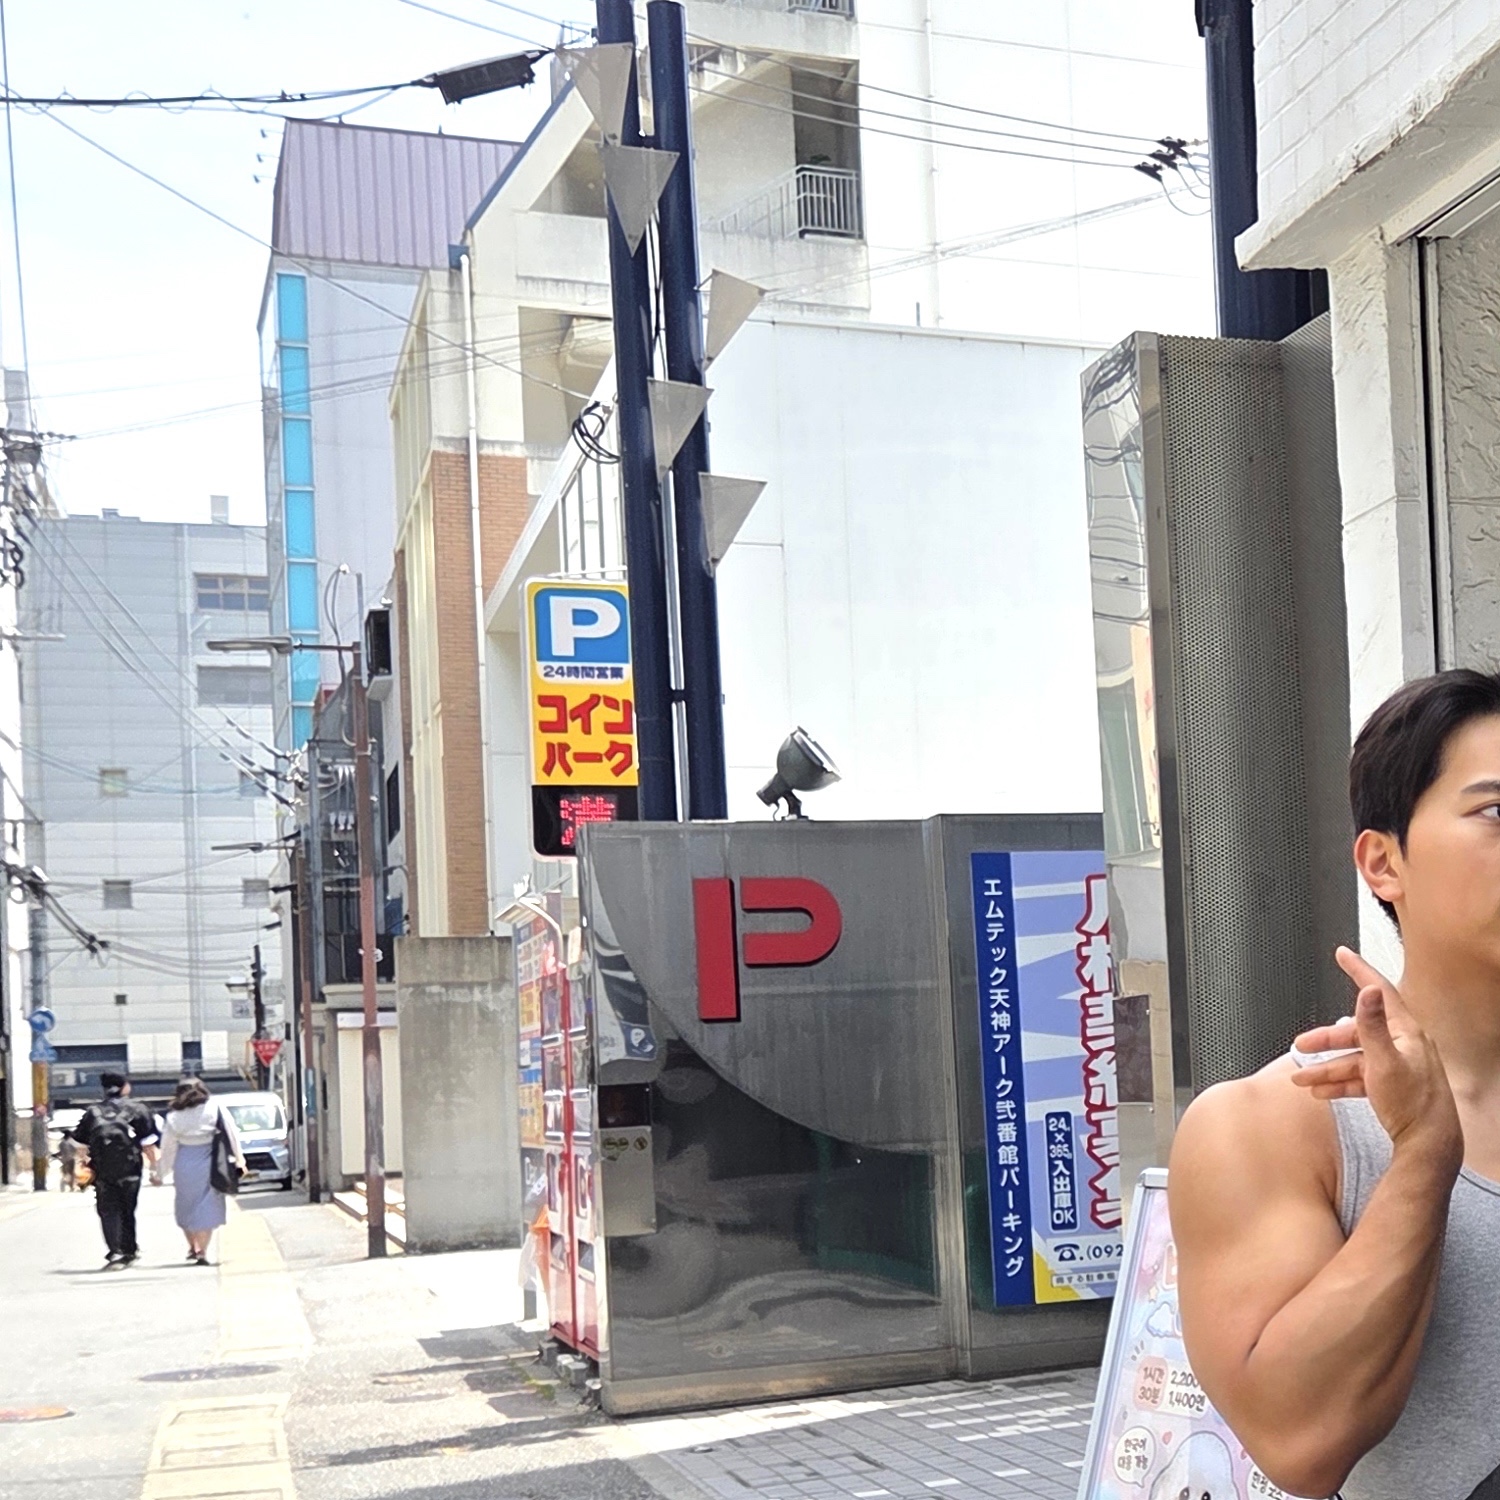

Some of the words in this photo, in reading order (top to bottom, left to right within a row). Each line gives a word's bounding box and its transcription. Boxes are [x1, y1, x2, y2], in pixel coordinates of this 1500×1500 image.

[549, 595, 621, 657] P
[543, 665, 624, 679] 24時間営業
[538, 693, 634, 735] コイン
[542, 741, 634, 777] パーク
[692, 876, 842, 1022] P
[983, 878, 1026, 1278] エムテック天神アーク弐番館パーキング
